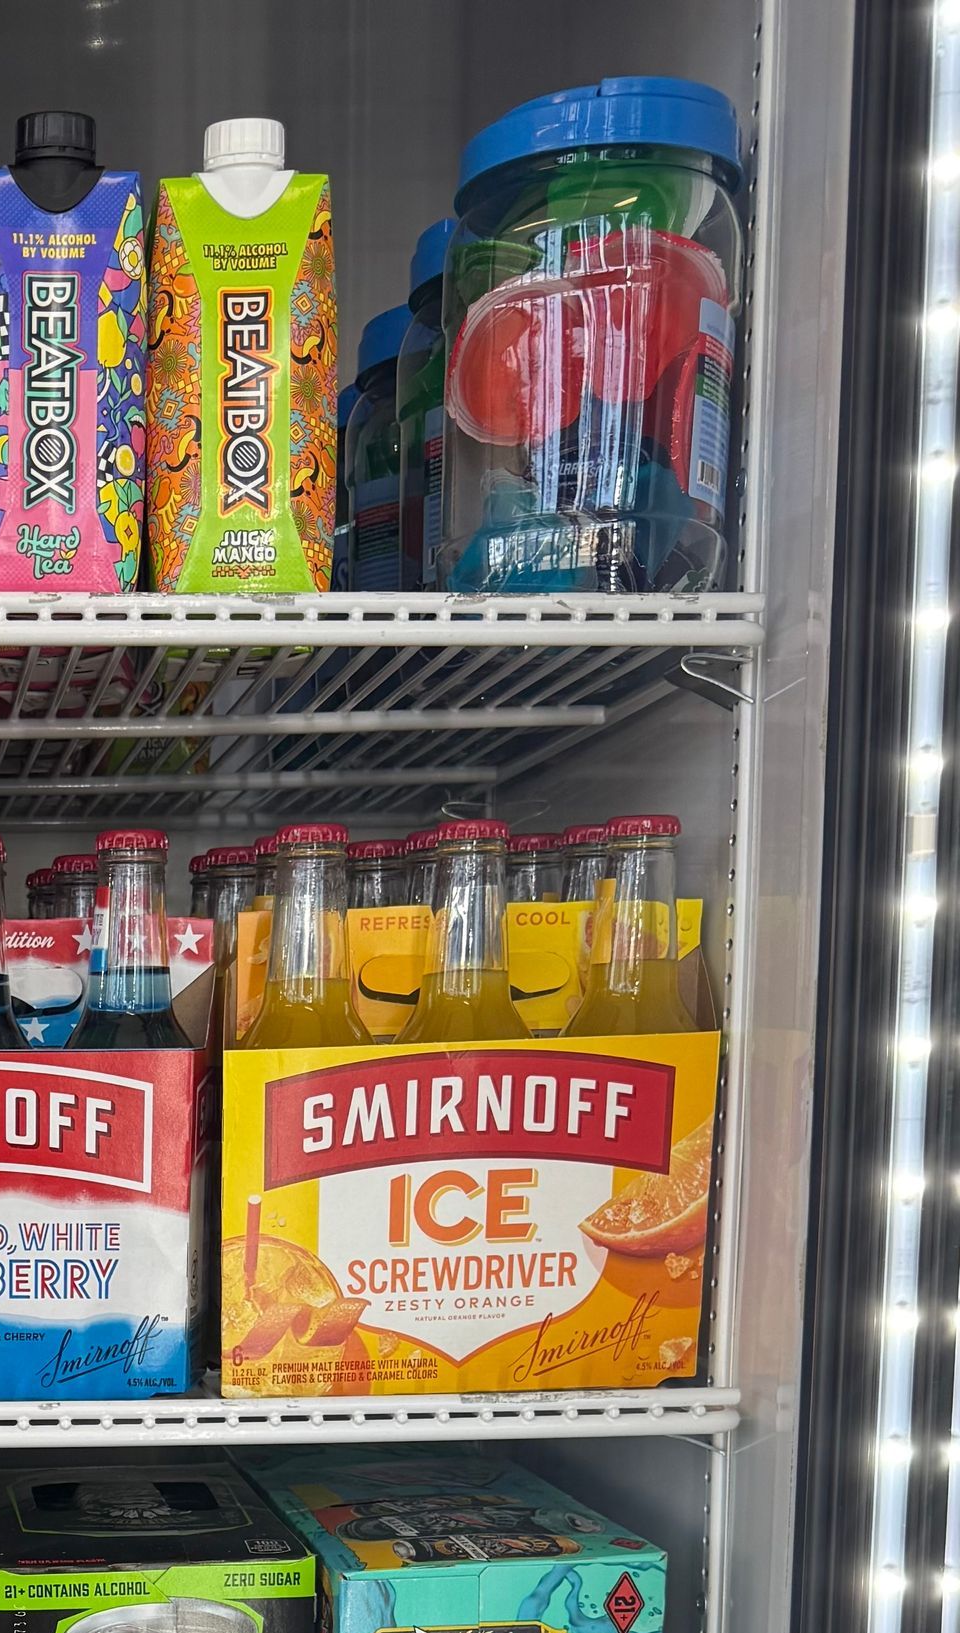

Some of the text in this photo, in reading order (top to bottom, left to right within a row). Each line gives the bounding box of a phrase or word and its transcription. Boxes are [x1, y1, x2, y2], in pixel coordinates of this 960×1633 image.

[12, 232, 97, 246] 11.1% ALCOHOL
[22, 247, 86, 259] BY VOLUME
[203, 243, 288, 258] 11.1% ALCOHOL
[212, 257, 276, 271] BY VOLUME
[27, 279, 79, 502] BEATBOX
[225, 293, 279, 511] BEATBOX
[17, 524, 80, 552] Hard
[220, 530, 275, 546] JUICY
[26, 549, 73, 578] Tea
[212, 546, 276, 564] MANGO
[516, 911, 571, 927] COOL
[303, 1075, 634, 1154] SMIRNOFF
[389, 1168, 539, 1248] ICE
[346, 1251, 577, 1296] SCREWDRIVER
[385, 1294, 535, 1312] ZESTY ORANGE
[507, 1290, 662, 1382] Smirnoff
[36, 1314, 163, 1388] Smirnoff
[272, 1358, 438, 1373] PREMIUM MALT BEVERAGE WITH NATURAL
[272, 1369, 438, 1385] FLAVORS & CERTIFIED & CARAMEL COLORS
[224, 1571, 301, 1588] ZERO SUGAR
[4, 1581, 151, 1600] 21+ CONTAINS ALCOHOL
